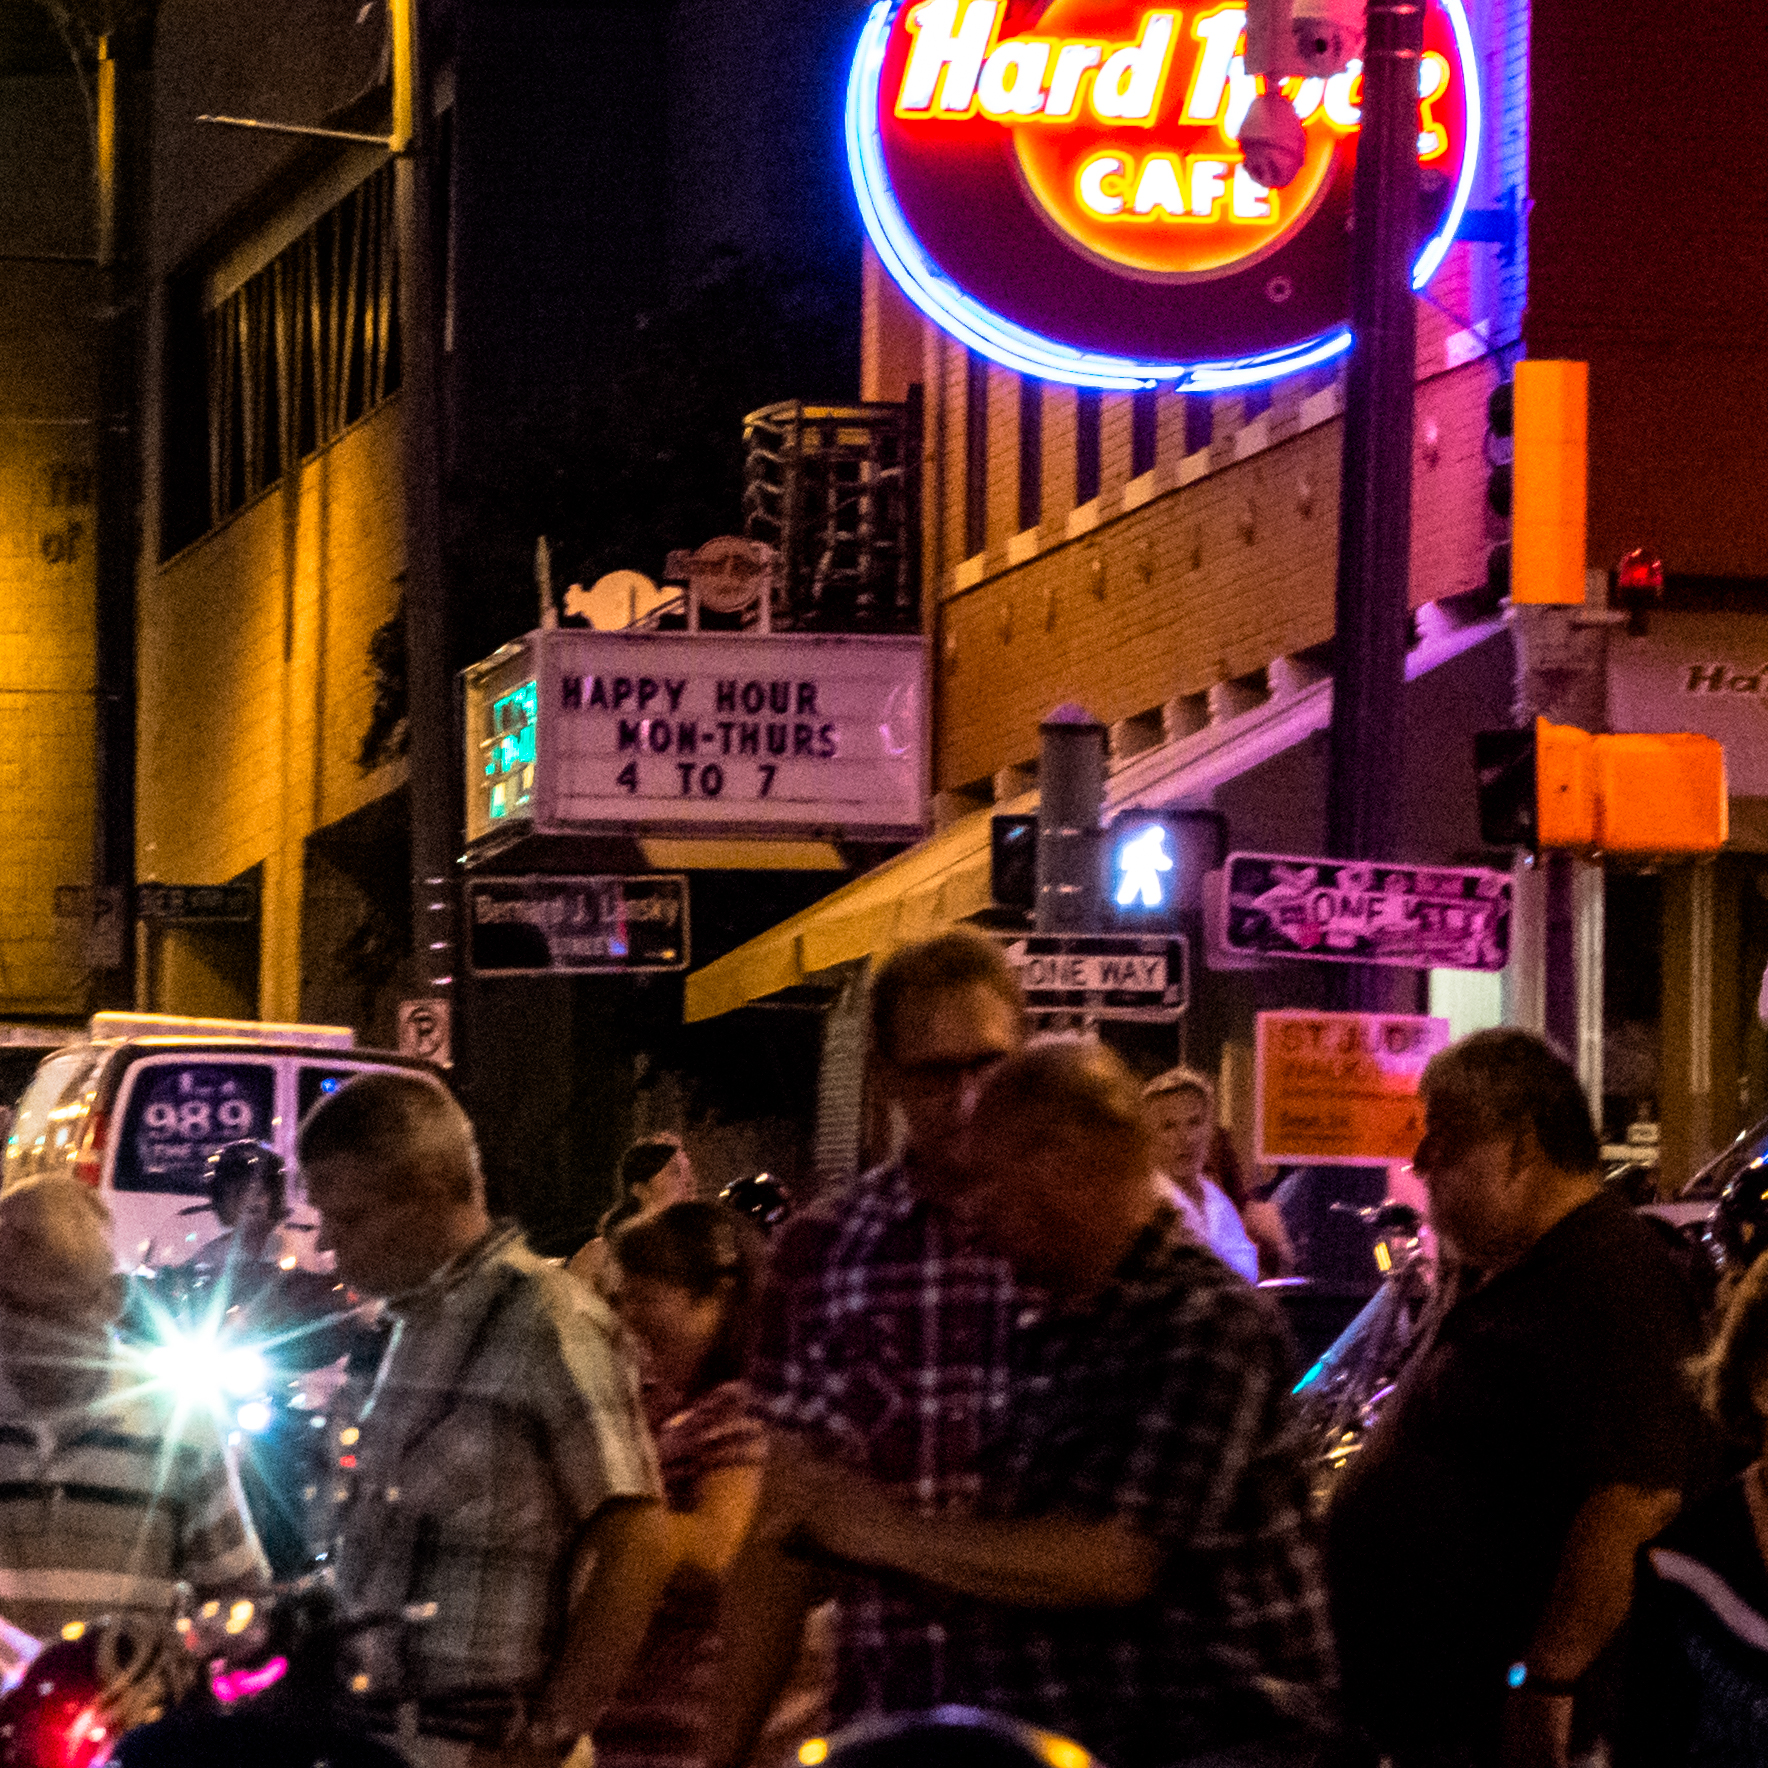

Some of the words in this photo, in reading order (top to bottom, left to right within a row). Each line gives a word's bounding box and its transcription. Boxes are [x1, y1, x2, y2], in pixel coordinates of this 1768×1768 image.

[1075, 150, 1280, 222] CAFE
[562, 675, 688, 713] HAPPY
[715, 678, 819, 716] HOUR
[618, 717, 838, 759] MON-THURS
[616, 763, 639, 795] 4
[676, 763, 724, 798] TO
[757, 763, 779, 796] 7
[1026, 958, 1086, 986] ONE
[1099, 957, 1160, 987] WAY
